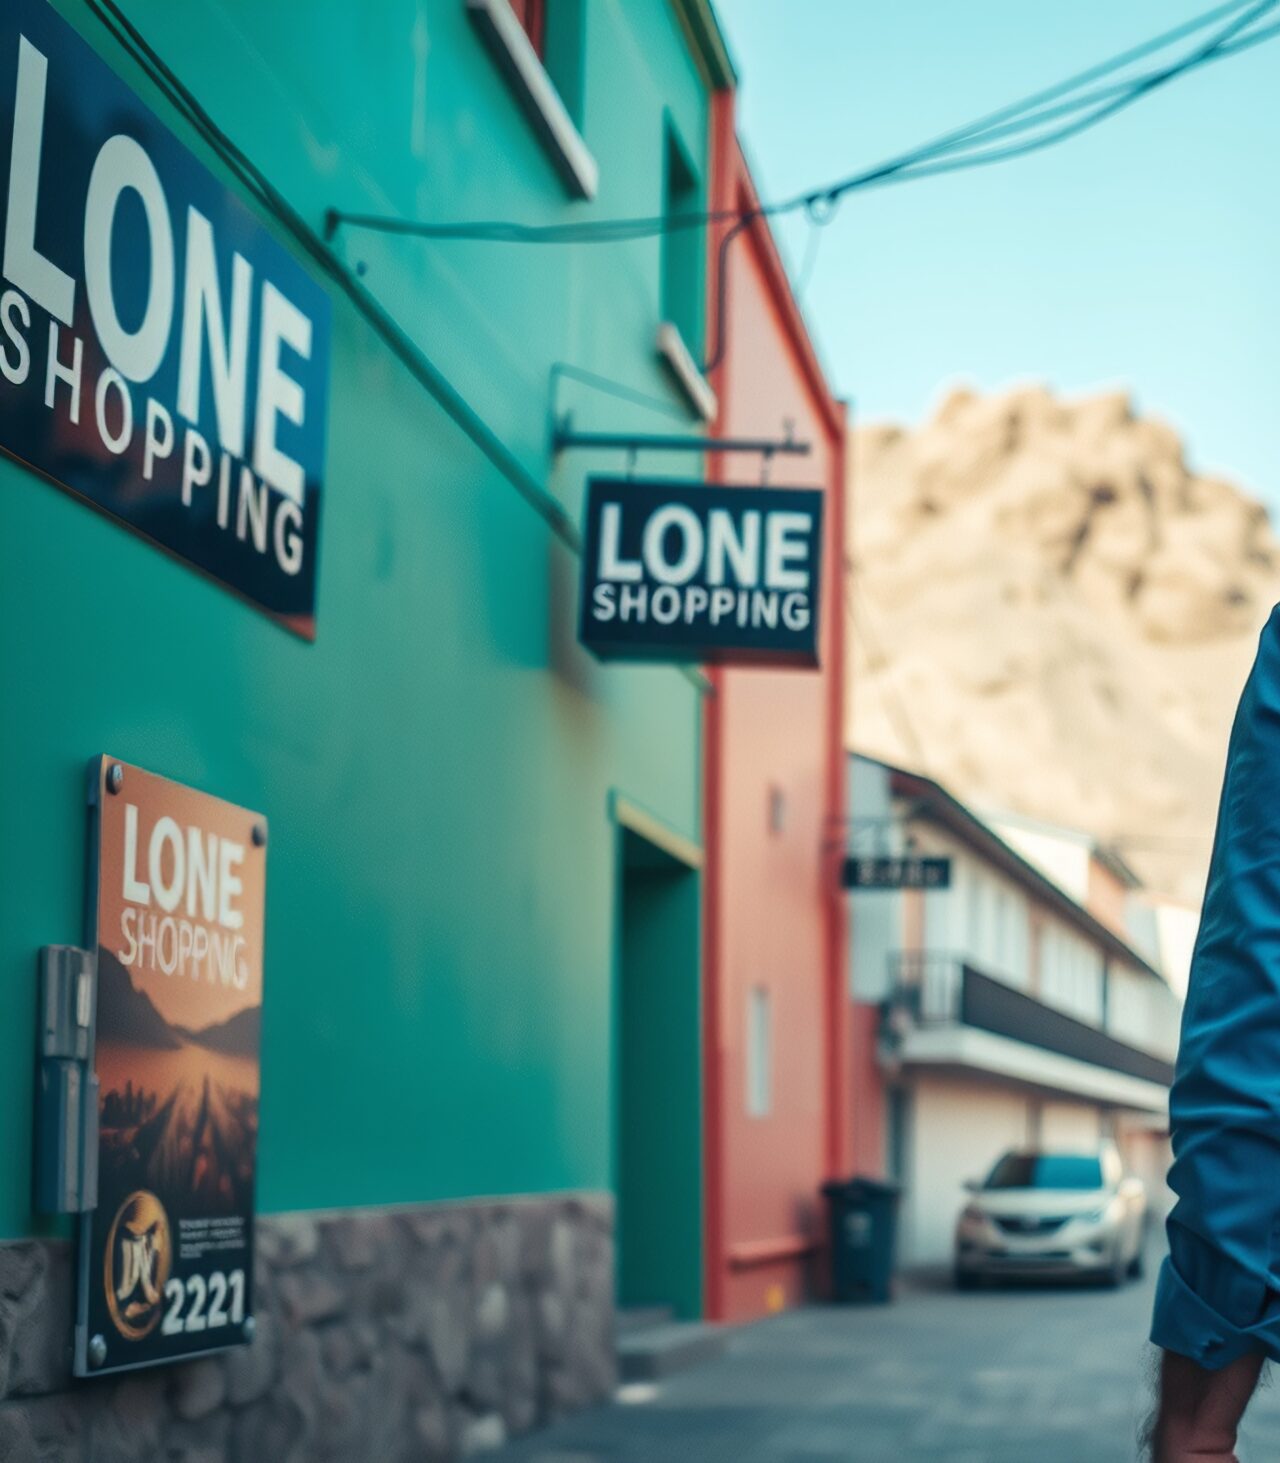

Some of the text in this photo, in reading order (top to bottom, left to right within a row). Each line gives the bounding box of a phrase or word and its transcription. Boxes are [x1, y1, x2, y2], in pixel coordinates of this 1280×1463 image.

[3, 33, 312, 508] LONE
[0, 290, 304, 576] SHOPPING
[598, 502, 812, 590] LONE
[593, 583, 810, 631] SHOPPING
[123, 803, 244, 929] LONE
[161, 1269, 245, 1336] 2221
